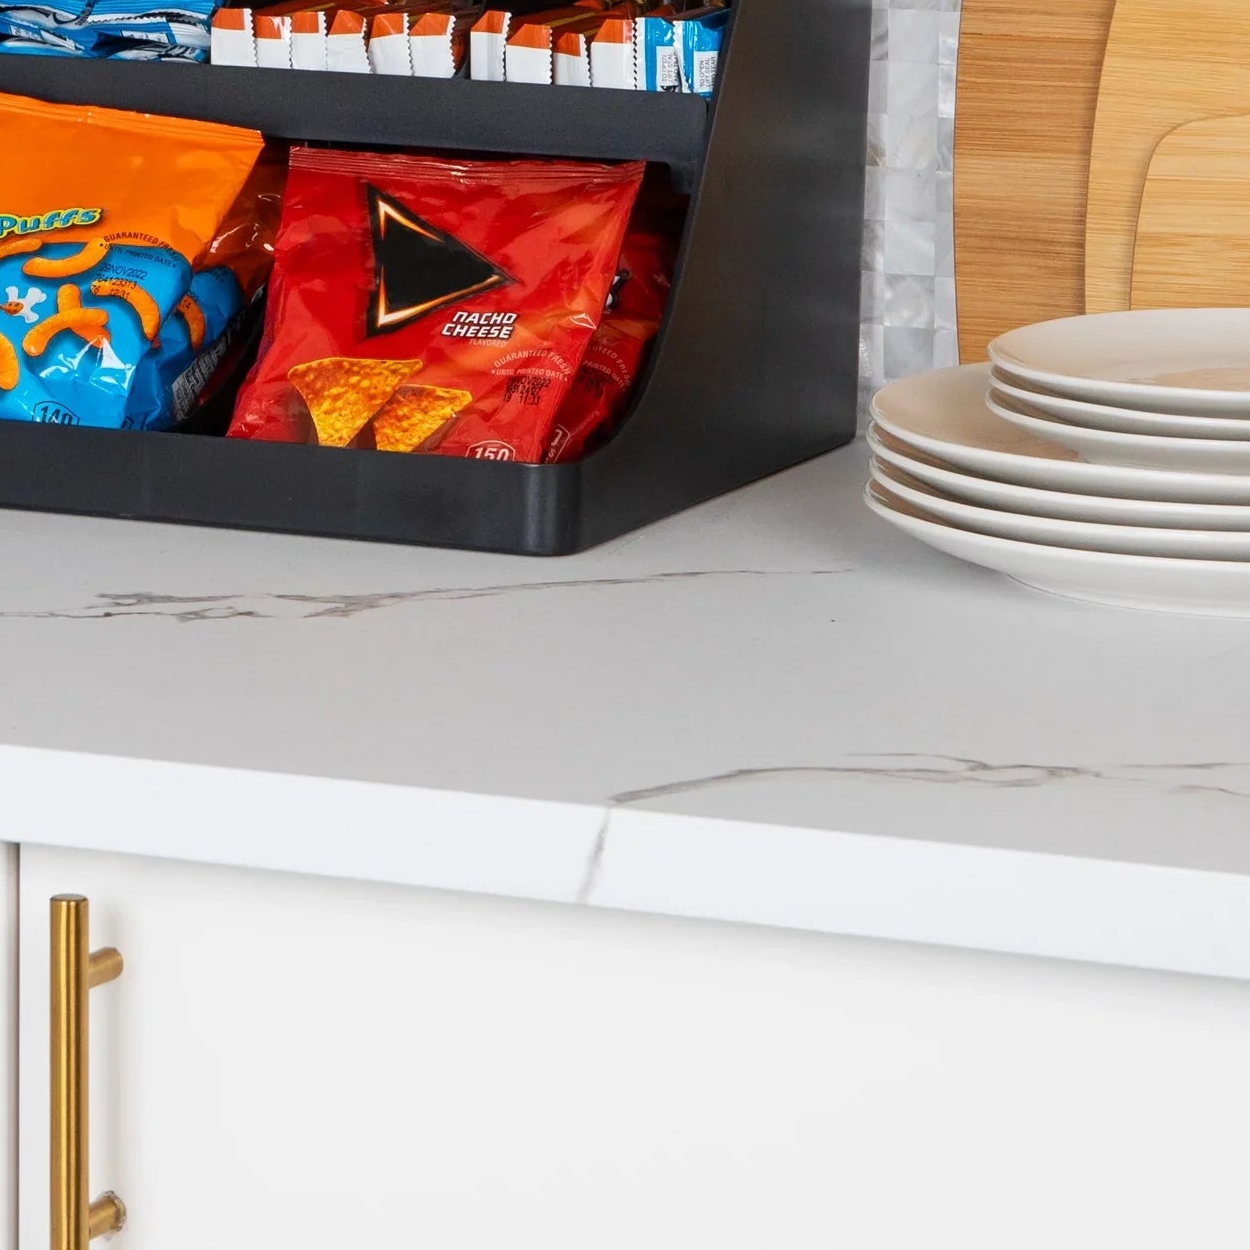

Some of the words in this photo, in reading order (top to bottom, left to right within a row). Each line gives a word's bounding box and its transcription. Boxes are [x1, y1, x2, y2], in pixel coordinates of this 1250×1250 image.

[103, 232, 159, 245] GUARANTEED
[124, 249, 153, 261] PRINTED
[153, 255, 172, 268] DATE
[452, 311, 518, 325] NACHO
[441, 323, 514, 339] CHEESE
[469, 338, 507, 348] FLAVORED
[494, 350, 548, 368] GUARANTEED
[548, 351, 572, 375] FRESH
[516, 367, 544, 377] PRINTED
[544, 369, 564, 379] DATE
